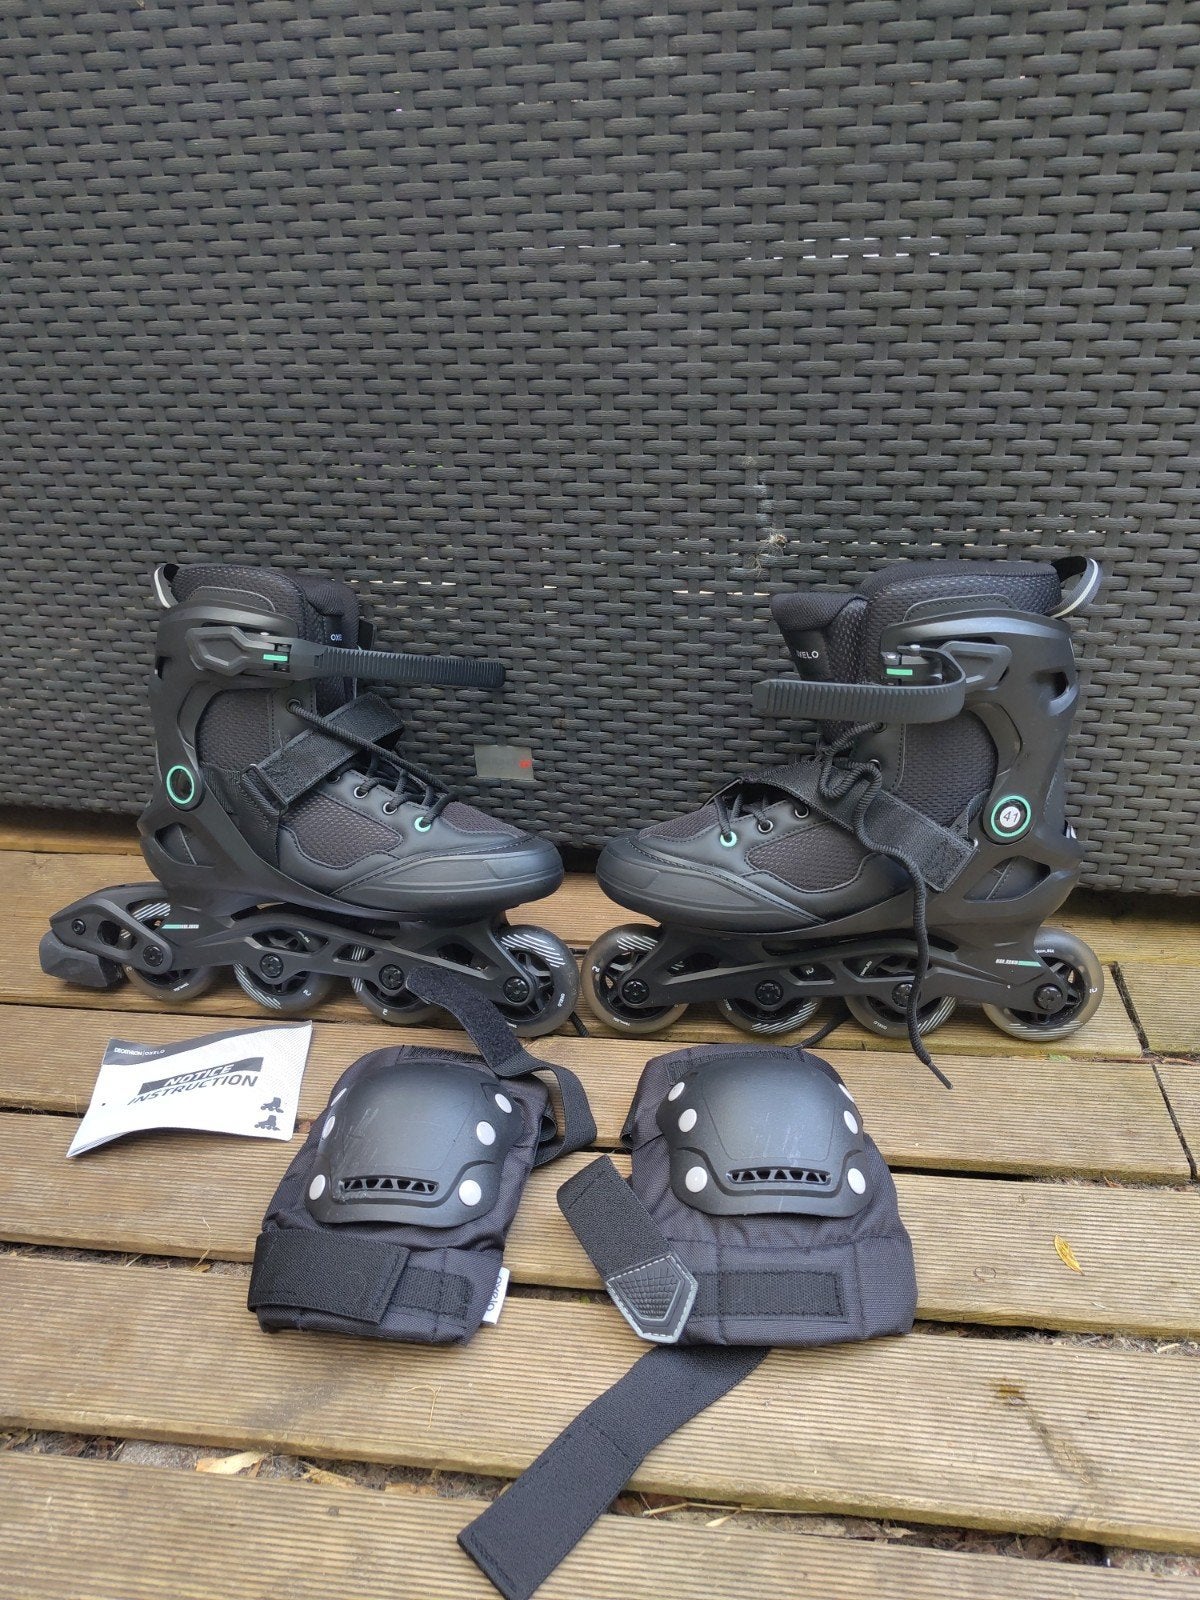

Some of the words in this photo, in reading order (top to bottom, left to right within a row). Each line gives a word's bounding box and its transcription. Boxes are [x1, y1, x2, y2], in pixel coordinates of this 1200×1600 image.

[1003, 810, 1019, 822] 41
[164, 1063, 235, 1087] NOTICE
[126, 1074, 258, 1106] INSTRUCTION
